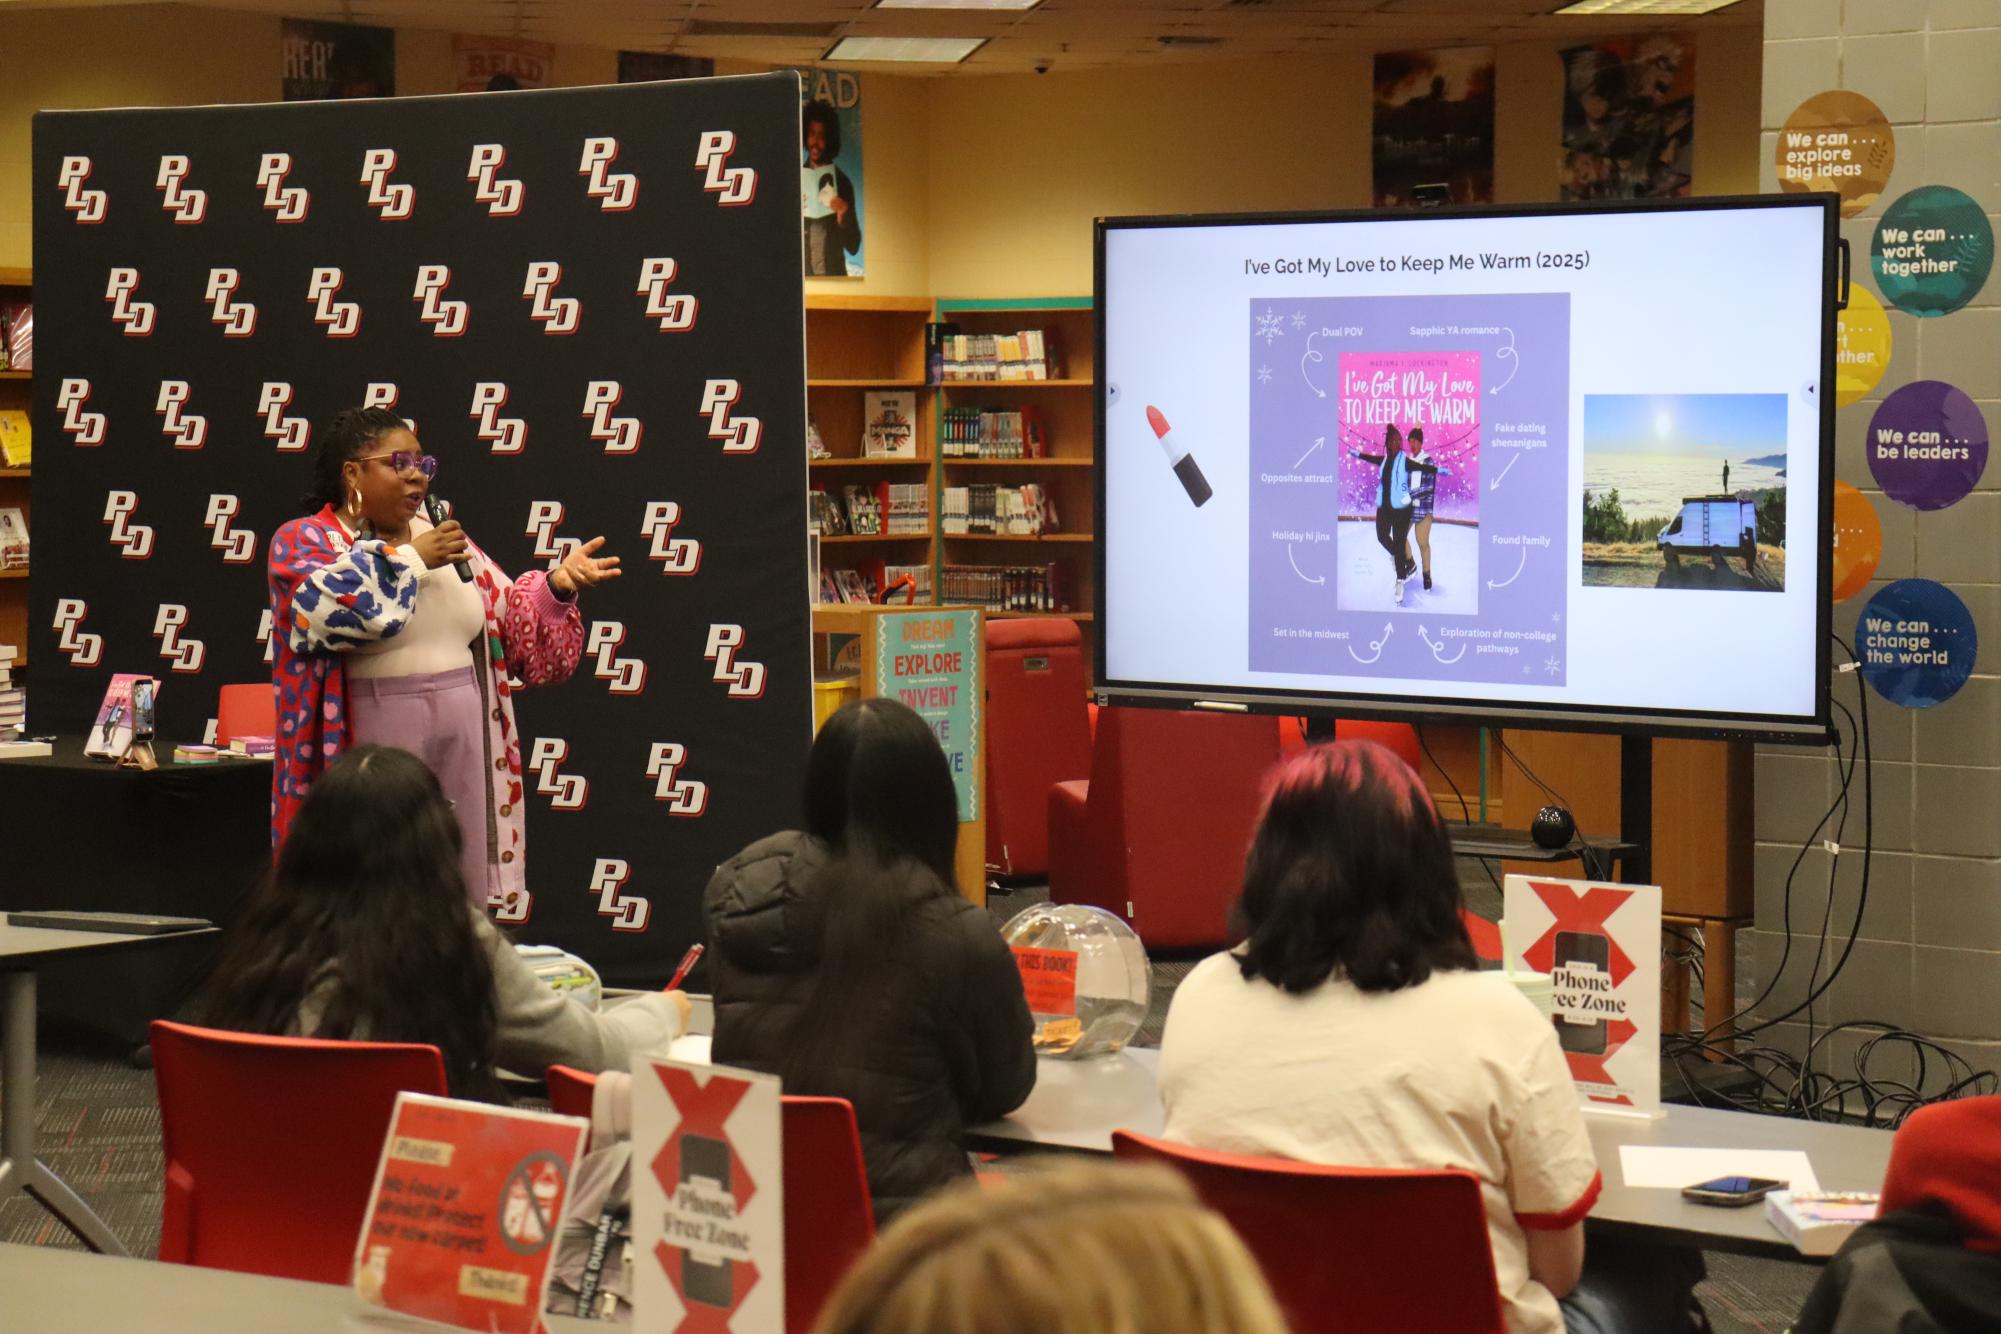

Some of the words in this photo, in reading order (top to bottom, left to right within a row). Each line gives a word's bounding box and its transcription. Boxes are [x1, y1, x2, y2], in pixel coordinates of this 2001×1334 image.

[1786, 133, 1812, 147] We
[1786, 148, 1852, 165] explore
[361, 149, 416, 220] PLD
[466, 144, 526, 217] PLD
[580, 137, 640, 213] PLD
[695, 131, 759, 206] PLD
[1786, 164, 1813, 181] big
[1817, 163, 1863, 177] ideas
[59, 157, 108, 224] PLD
[157, 156, 208, 224] PLD
[257, 153, 310, 224] PLD
[1881, 229, 1909, 243] We
[1882, 243, 1926, 259] work
[1245, 259, 1270, 275] I've
[1274, 258, 1303, 274] Got
[1308, 257, 1331, 278] My
[1336, 257, 1375, 273] Love
[1380, 256, 1396, 272] to
[1401, 255, 1444, 275] Keep
[1449, 254, 1475, 270] Me
[1480, 253, 1531, 269] Warm
[1536, 250, 1590, 270] (2025)
[1882, 258, 1958, 277] together
[106, 268, 157, 336] PLD
[206, 269, 258, 338] PLD
[306, 268, 362, 339] PLD
[414, 265, 470, 337] PLD
[523, 262, 583, 335] PLD
[637, 258, 700, 332] PLD
[1322, 327, 1342, 337] Dual
[1344, 327, 1364, 337] POV
[1409, 326, 1445, 338] Sapphic
[1447, 326, 1459, 336] YA
[1460, 326, 1500, 336] romance
[1345, 370, 1369, 396] I've
[1371, 370, 1398, 398] Got
[1402, 370, 1438, 405] My
[1441, 371, 1475, 397] Love
[57, 379, 108, 447] PLD
[156, 381, 208, 450] PLD
[257, 383, 311, 452] PLD
[471, 383, 528, 455] PLD
[583, 381, 644, 455] PLD
[700, 379, 764, 455] PLD
[1344, 398, 1361, 424] TO
[1366, 399, 1400, 424] KEEP
[1404, 398, 1426, 424] ME
[1430, 398, 1475, 424] WARM
[1495, 423, 1516, 433] Fake
[1517, 424, 1546, 435] dating
[1491, 438, 1547, 450] shenanigans
[1877, 429, 1904, 444] We
[1877, 444, 1899, 459] be
[1903, 444, 1969, 460] leaders
[1261, 473, 1303, 485] Opposites
[1304, 474, 1333, 483] attract
[104, 491, 155, 560] PLD
[205, 494, 256, 564] PLD
[641, 502, 703, 576] PLD
[1272, 530, 1304, 543] Holiday
[1492, 535, 1521, 545] Found
[1522, 535, 1551, 548] family
[54, 599, 104, 666] PLD
[154, 604, 205, 673] PLD
[902, 618, 956, 642] DREAM
[1273, 627, 1287, 637] Set
[1289, 628, 1297, 637] in
[1298, 629, 1312, 638] the
[1314, 629, 1350, 639] midwest
[1440, 627, 1491, 639] Exploration
[1493, 628, 1502, 638] of
[1504, 631, 1557, 643] non-college
[1866, 618, 1892, 633] We
[1866, 634, 1931, 651] change
[587, 621, 648, 695] PLD
[704, 624, 768, 699] PLD
[894, 652, 962, 677] EXPLORE
[1476, 645, 1519, 656] pathways
[1866, 649, 1894, 664] the
[1899, 650, 1948, 665] world
[898, 685, 960, 711] INVENT
[529, 738, 589, 811] PLD
[646, 743, 709, 817] PLD
[590, 859, 652, 932] PLD
[1553, 970, 1610, 992] Phone
[1580, 993, 1627, 1014] Zone
[679, 1188, 734, 1220] Phone
[664, 1212, 703, 1241] Free
[706, 1222, 751, 1251] Zone
